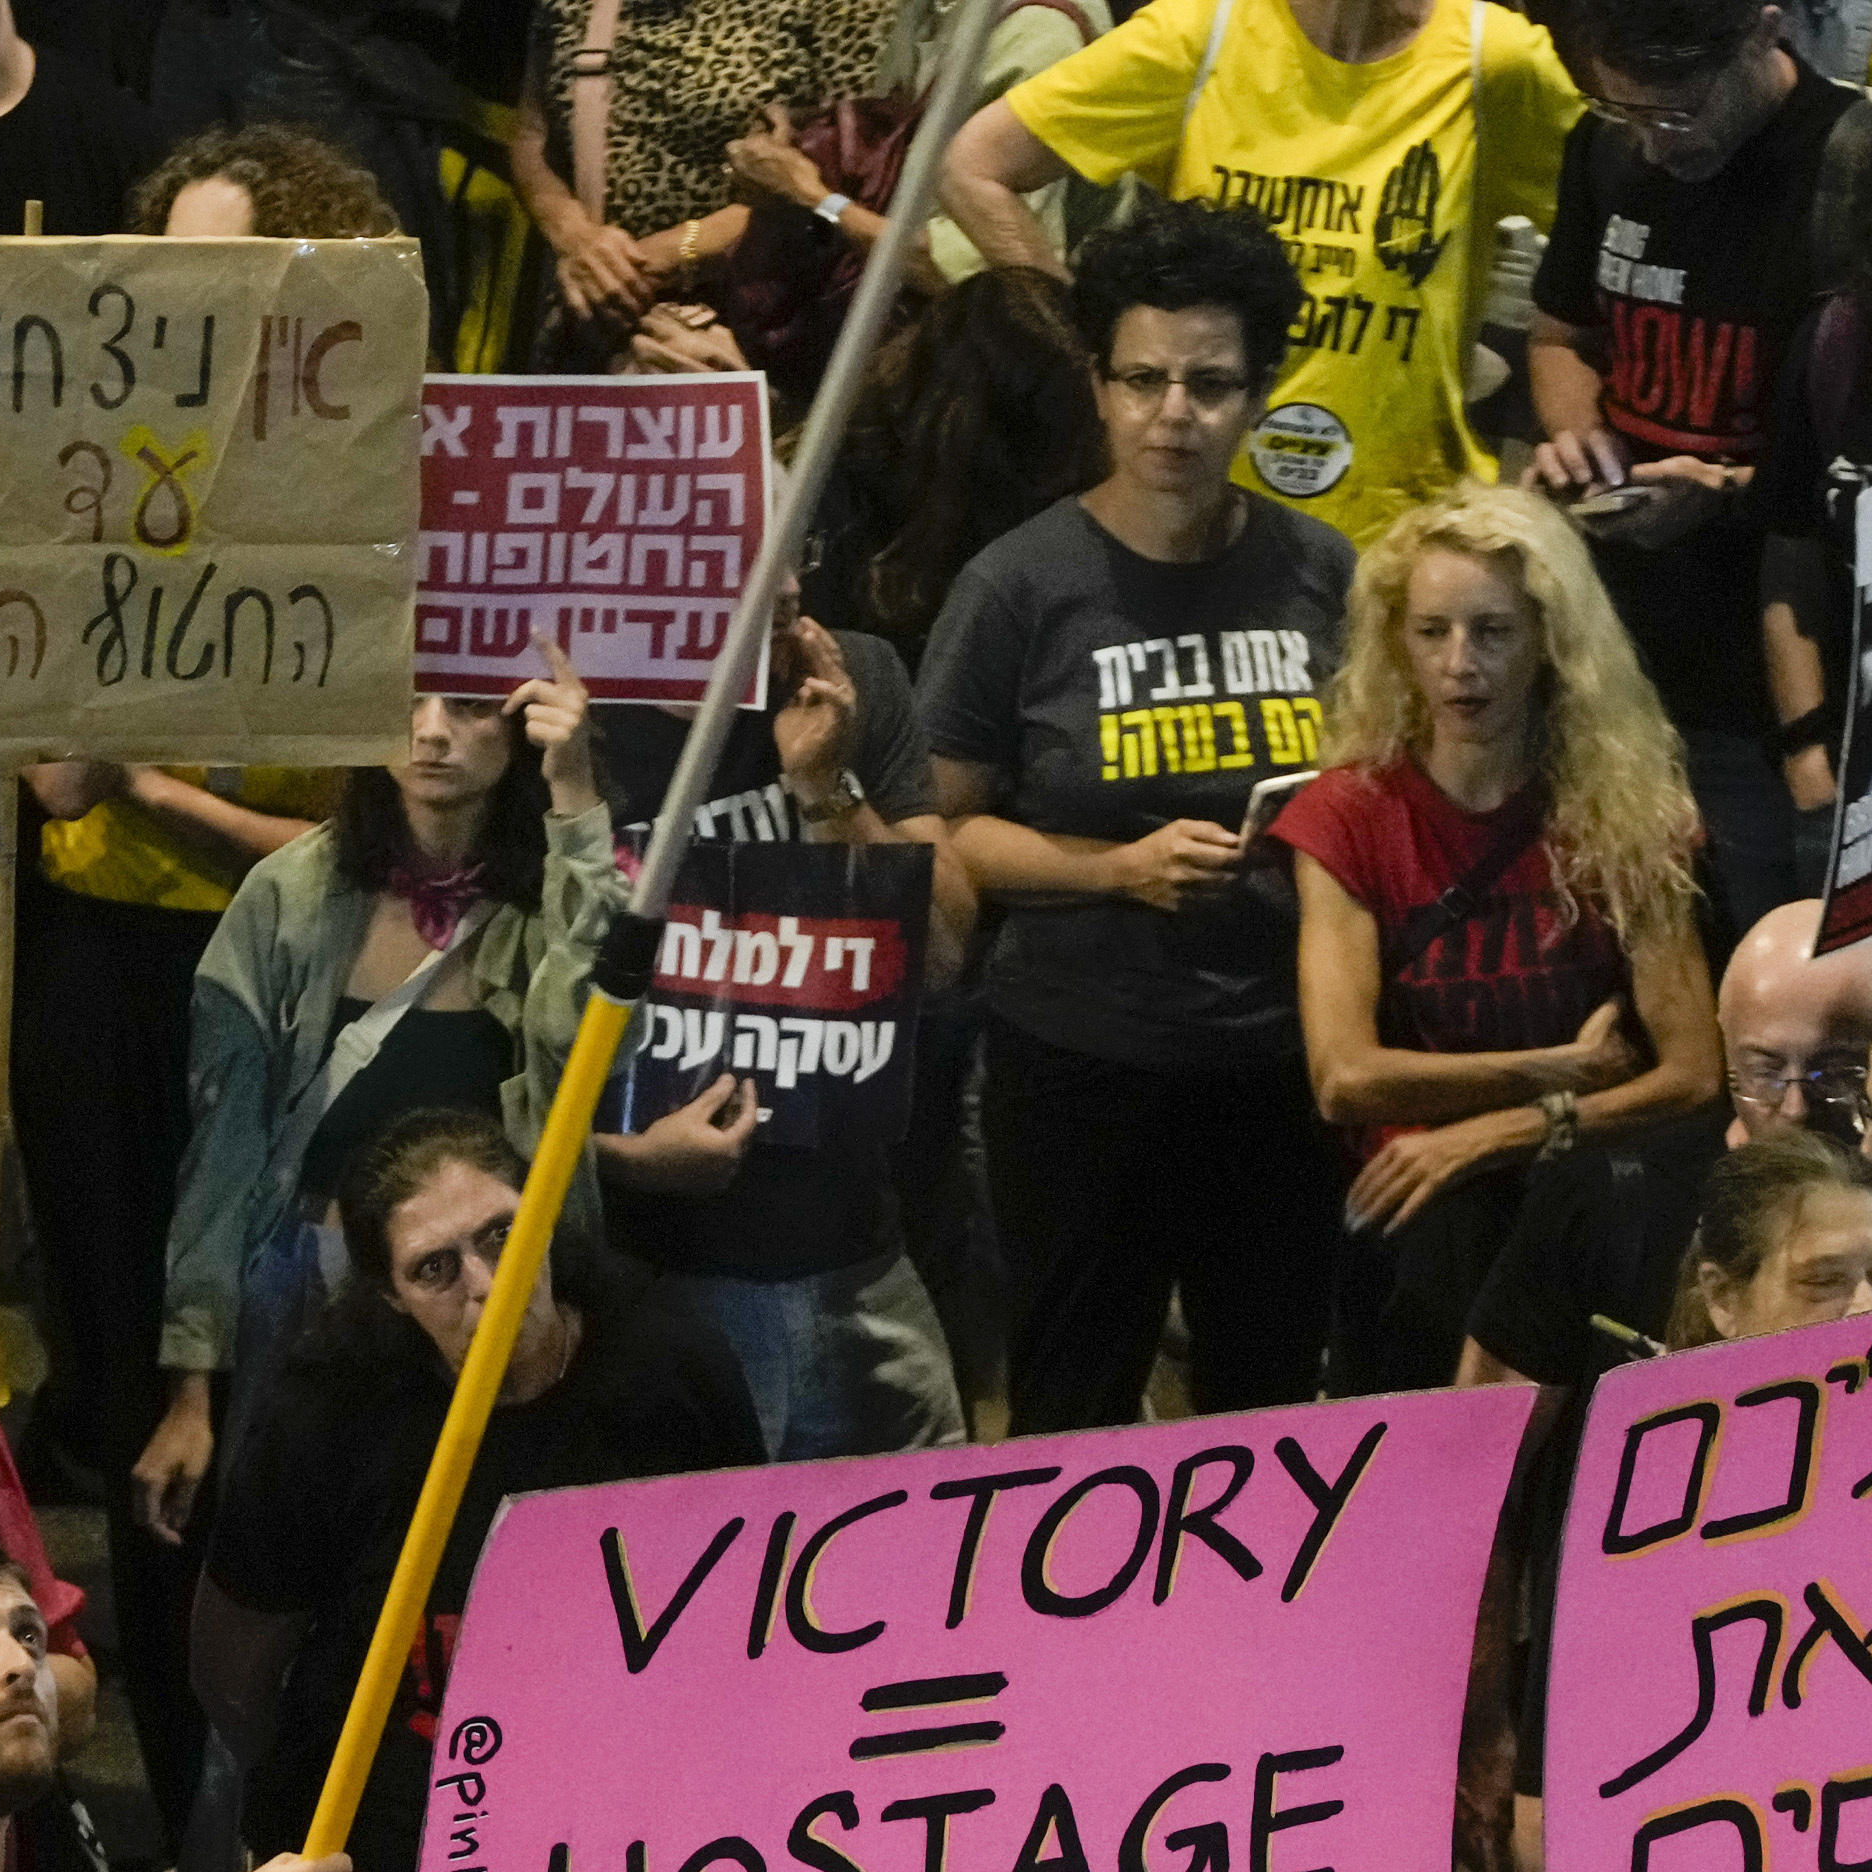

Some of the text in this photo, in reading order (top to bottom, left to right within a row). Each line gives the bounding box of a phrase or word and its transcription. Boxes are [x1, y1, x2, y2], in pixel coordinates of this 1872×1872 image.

[253, 314, 364, 442] אין
[420, 403, 744, 460] עוצרות א
[58, 437, 199, 549] עד
[504, 465, 745, 527] העולם
[82, 551, 335, 689] החטוף
[414, 603, 730, 664] עדיין שם
[1091, 629, 1314, 709] אתם בבית
[1098, 697, 1324, 783] הם בעזה!
[659, 909, 876, 992] די למלח
[731, 1013, 897, 1090] עסקה
[600, 1417, 1389, 1674] VICTORY
[847, 1668, 1010, 1764] =
